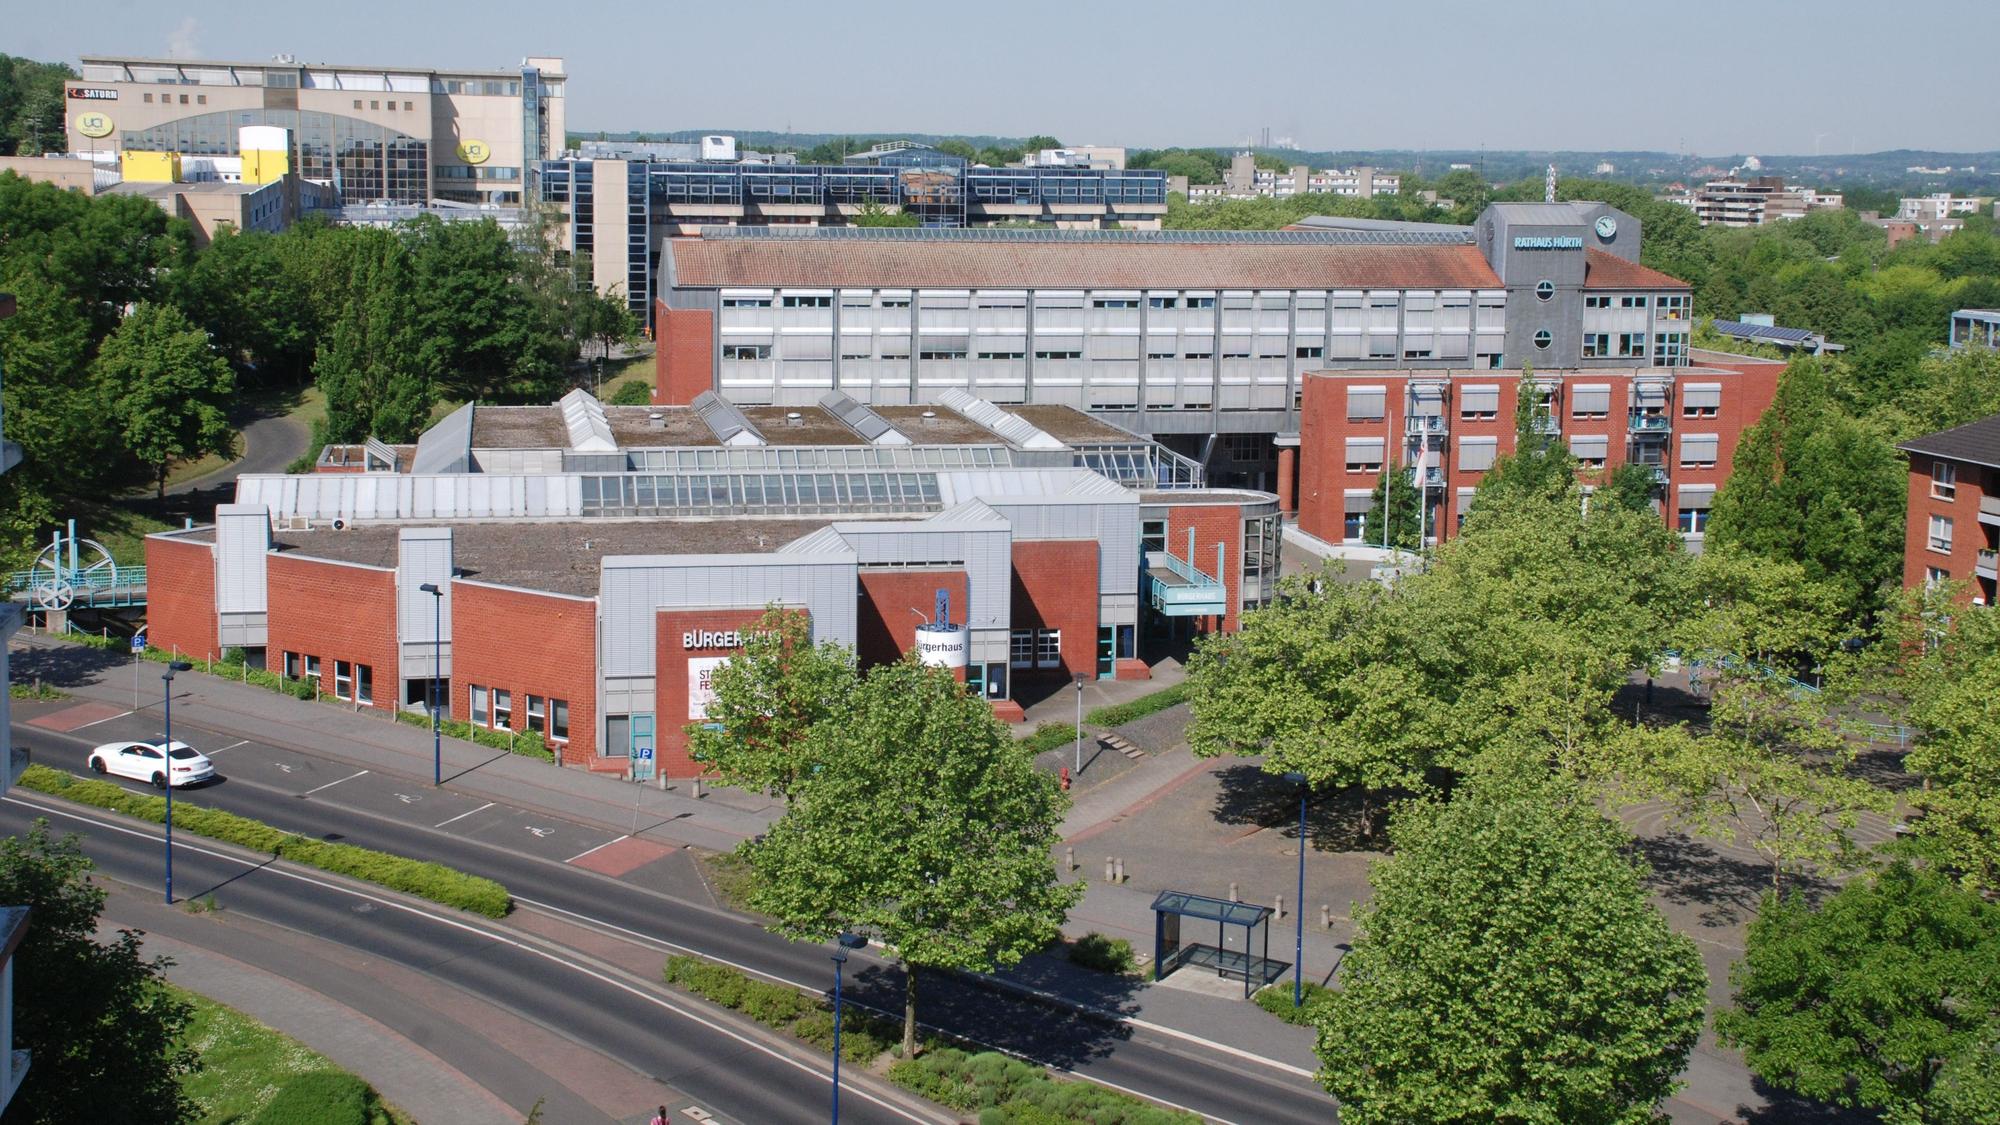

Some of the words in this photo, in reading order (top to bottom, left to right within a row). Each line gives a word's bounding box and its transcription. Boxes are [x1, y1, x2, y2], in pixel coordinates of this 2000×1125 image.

[84, 89, 117, 98] SATURN
[83, 117, 103, 128] UCI
[464, 144, 481, 155] UCI
[1514, 237, 1552, 248] RATHAUS
[1553, 235, 1582, 248] HÜRTH
